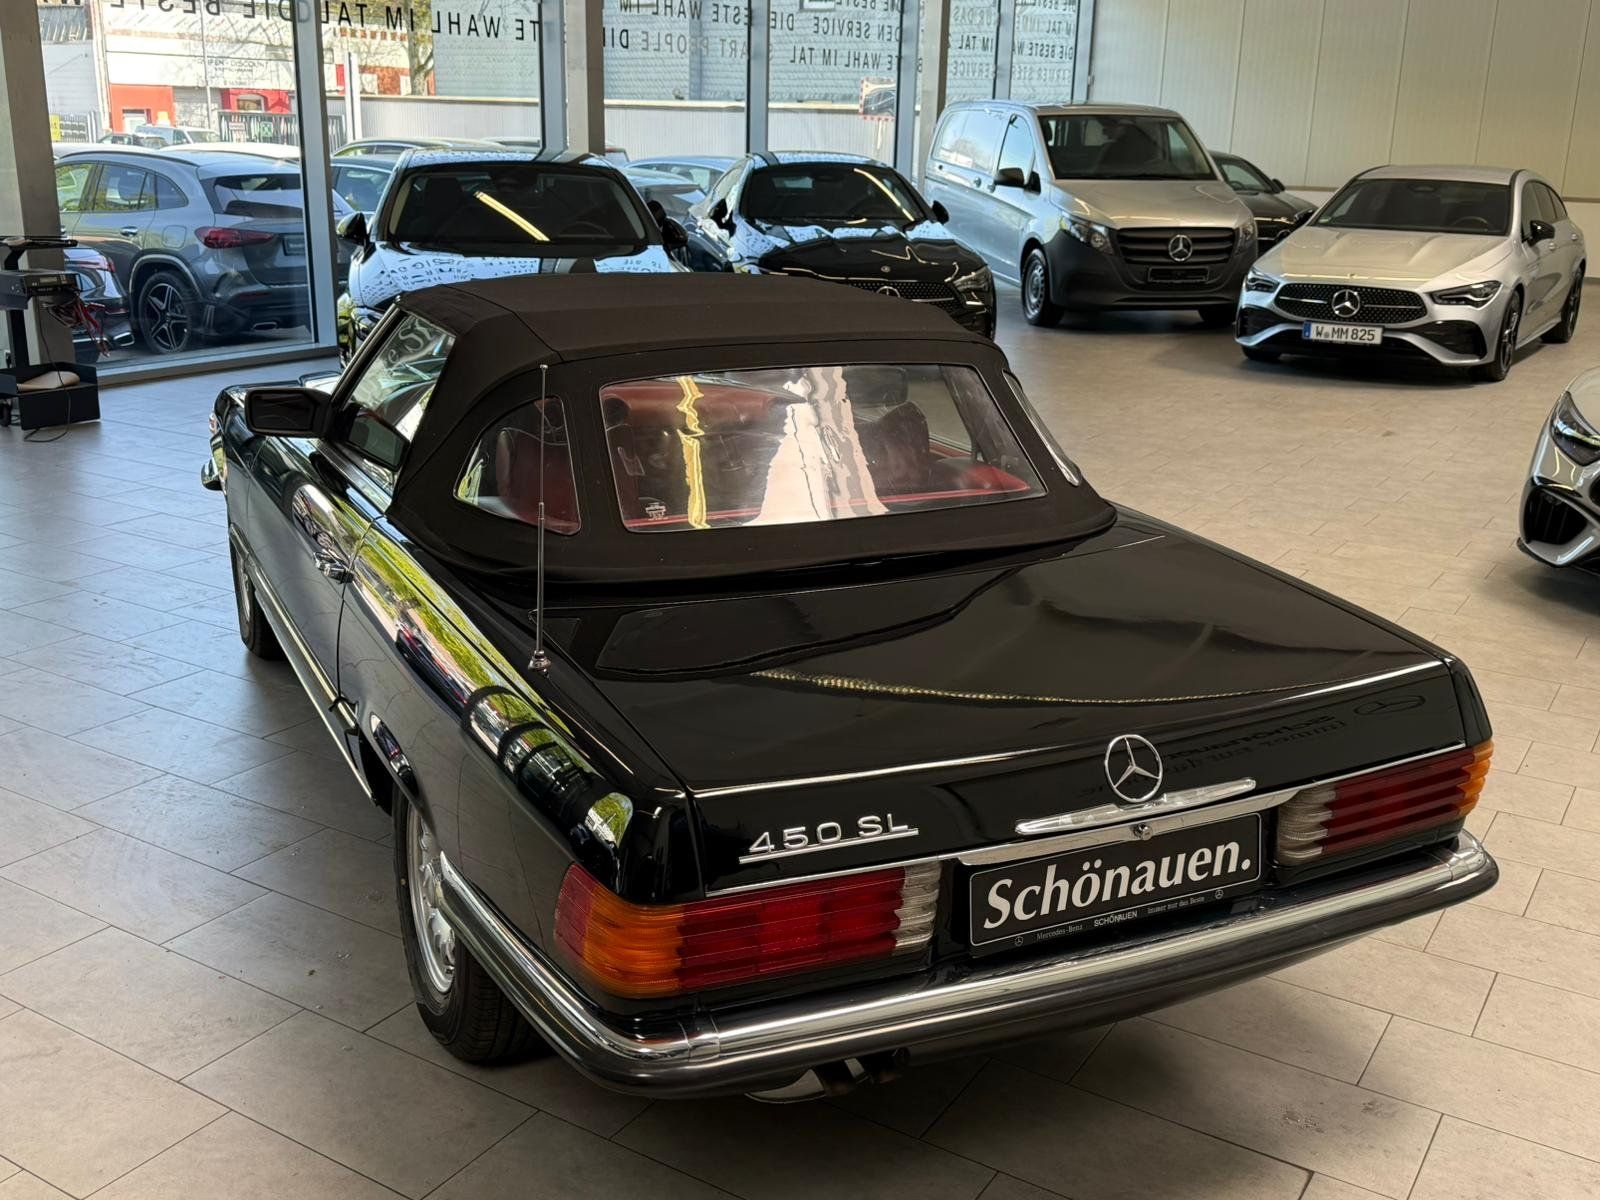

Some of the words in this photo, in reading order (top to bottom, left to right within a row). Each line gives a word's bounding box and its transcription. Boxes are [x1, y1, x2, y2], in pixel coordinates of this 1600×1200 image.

[1350, 328, 1376, 342] 825
[749, 821, 842, 854] 450
[857, 813, 909, 838] SL
[983, 840, 1252, 930] Schönauen.
[1093, 910, 1138, 927] SCHÖNAUEN
